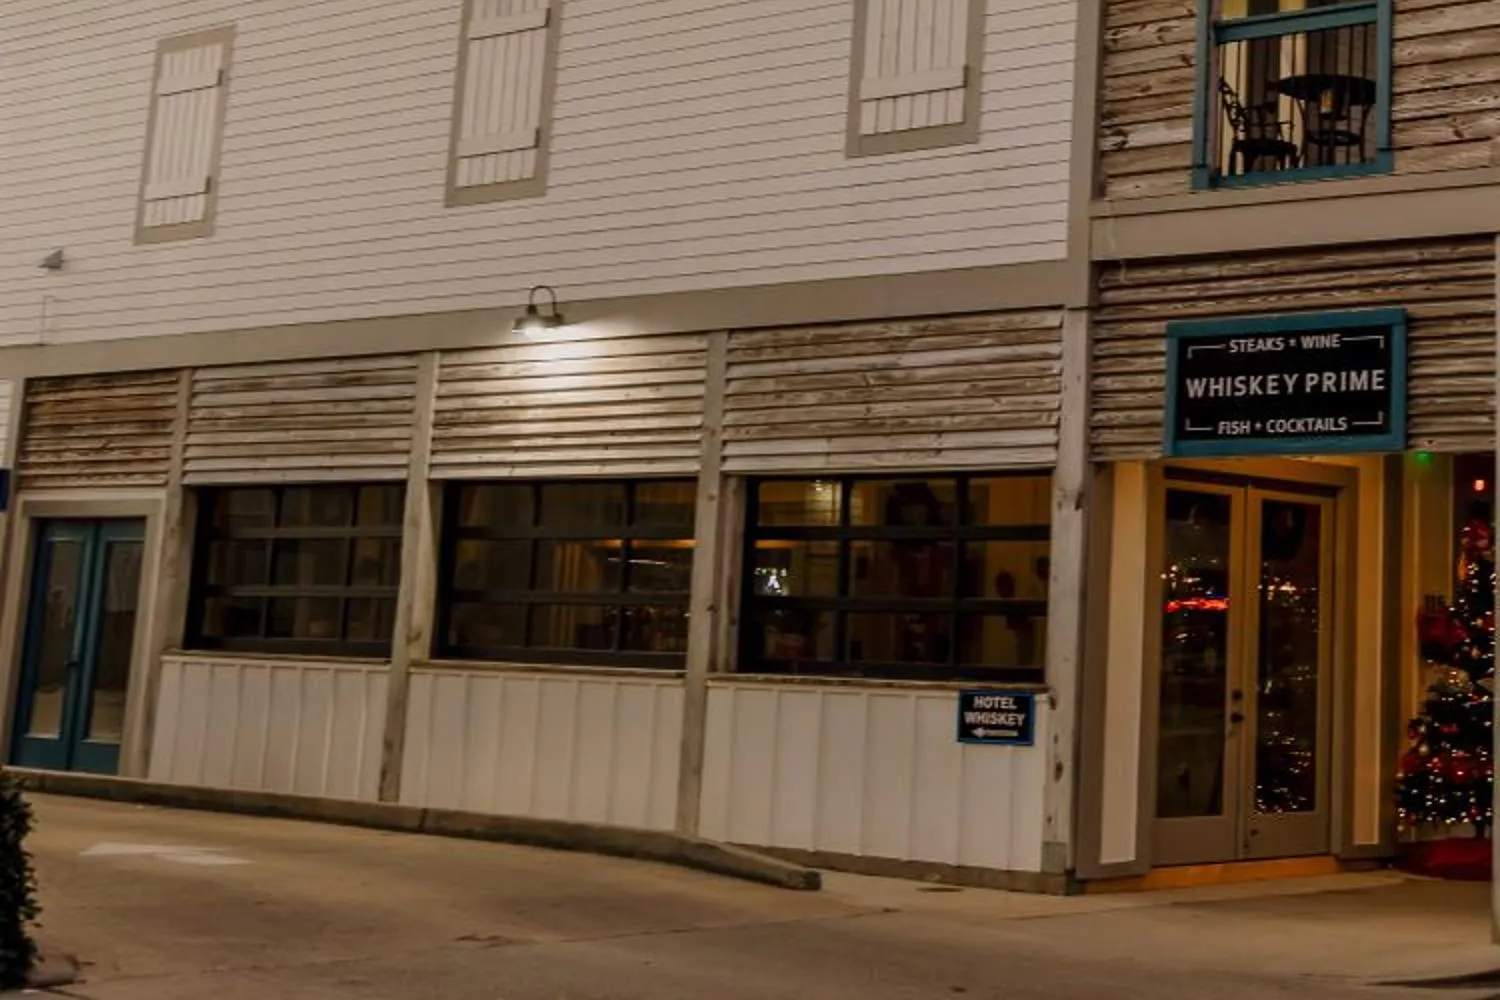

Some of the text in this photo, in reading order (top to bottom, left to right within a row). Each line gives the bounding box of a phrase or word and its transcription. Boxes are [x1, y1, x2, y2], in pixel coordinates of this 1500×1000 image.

[1229, 333, 1341, 353] STEAKS WINE
[1186, 369, 1386, 398] WHISKEY PRIME
[1217, 416, 1348, 434] FISH COCKTAILS
[973, 695, 1018, 710] HOTEL
[963, 711, 1026, 727] WHISKEY
